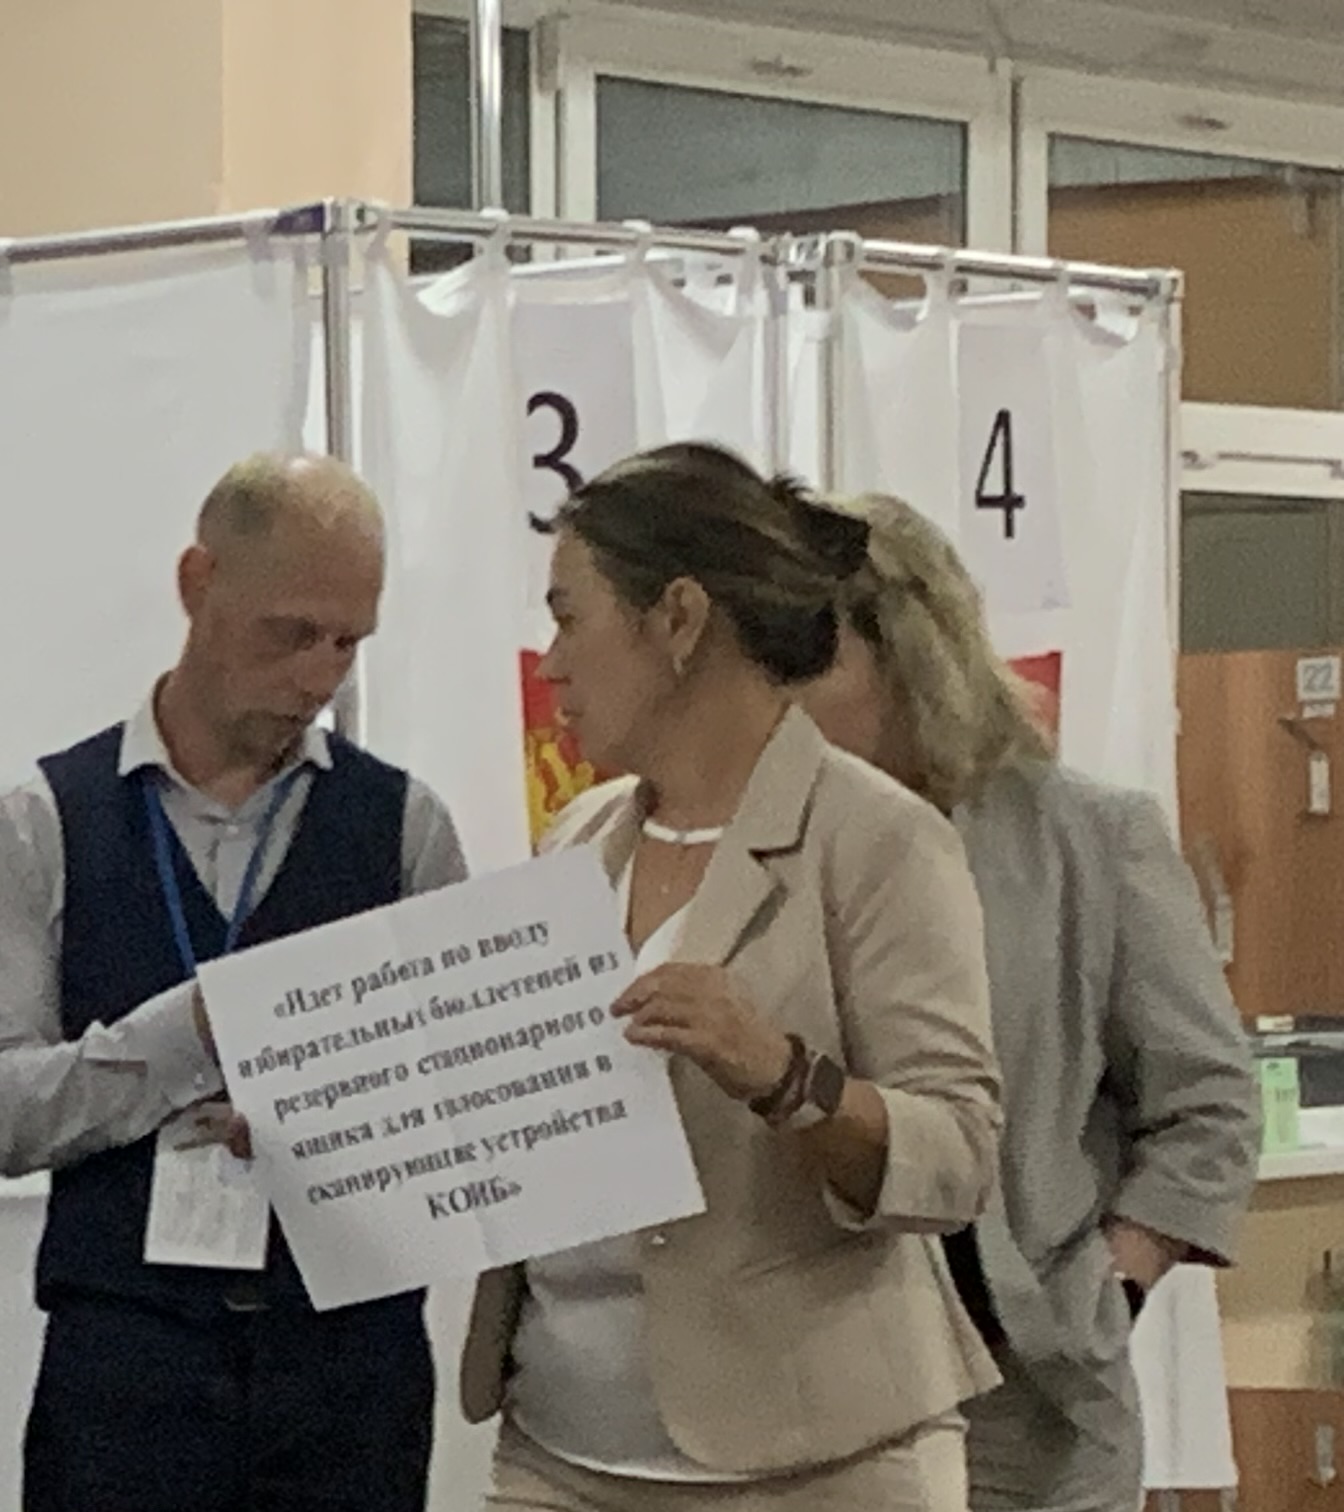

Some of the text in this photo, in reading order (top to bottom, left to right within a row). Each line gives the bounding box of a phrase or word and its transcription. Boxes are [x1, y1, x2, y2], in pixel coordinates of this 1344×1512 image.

[526, 391, 584, 534] 3
[975, 409, 1025, 539] 4
[351, 957, 435, 1005] работа
[441, 944, 472, 969] по
[477, 922, 548, 958] вводу
[588, 952, 619, 976] из
[274, 1006, 605, 1124] резервного стационарного
[291, 1122, 374, 1160] ящика
[382, 1108, 426, 1137] для
[595, 1055, 612, 1072] в
[480, 1099, 627, 1162] устройства
